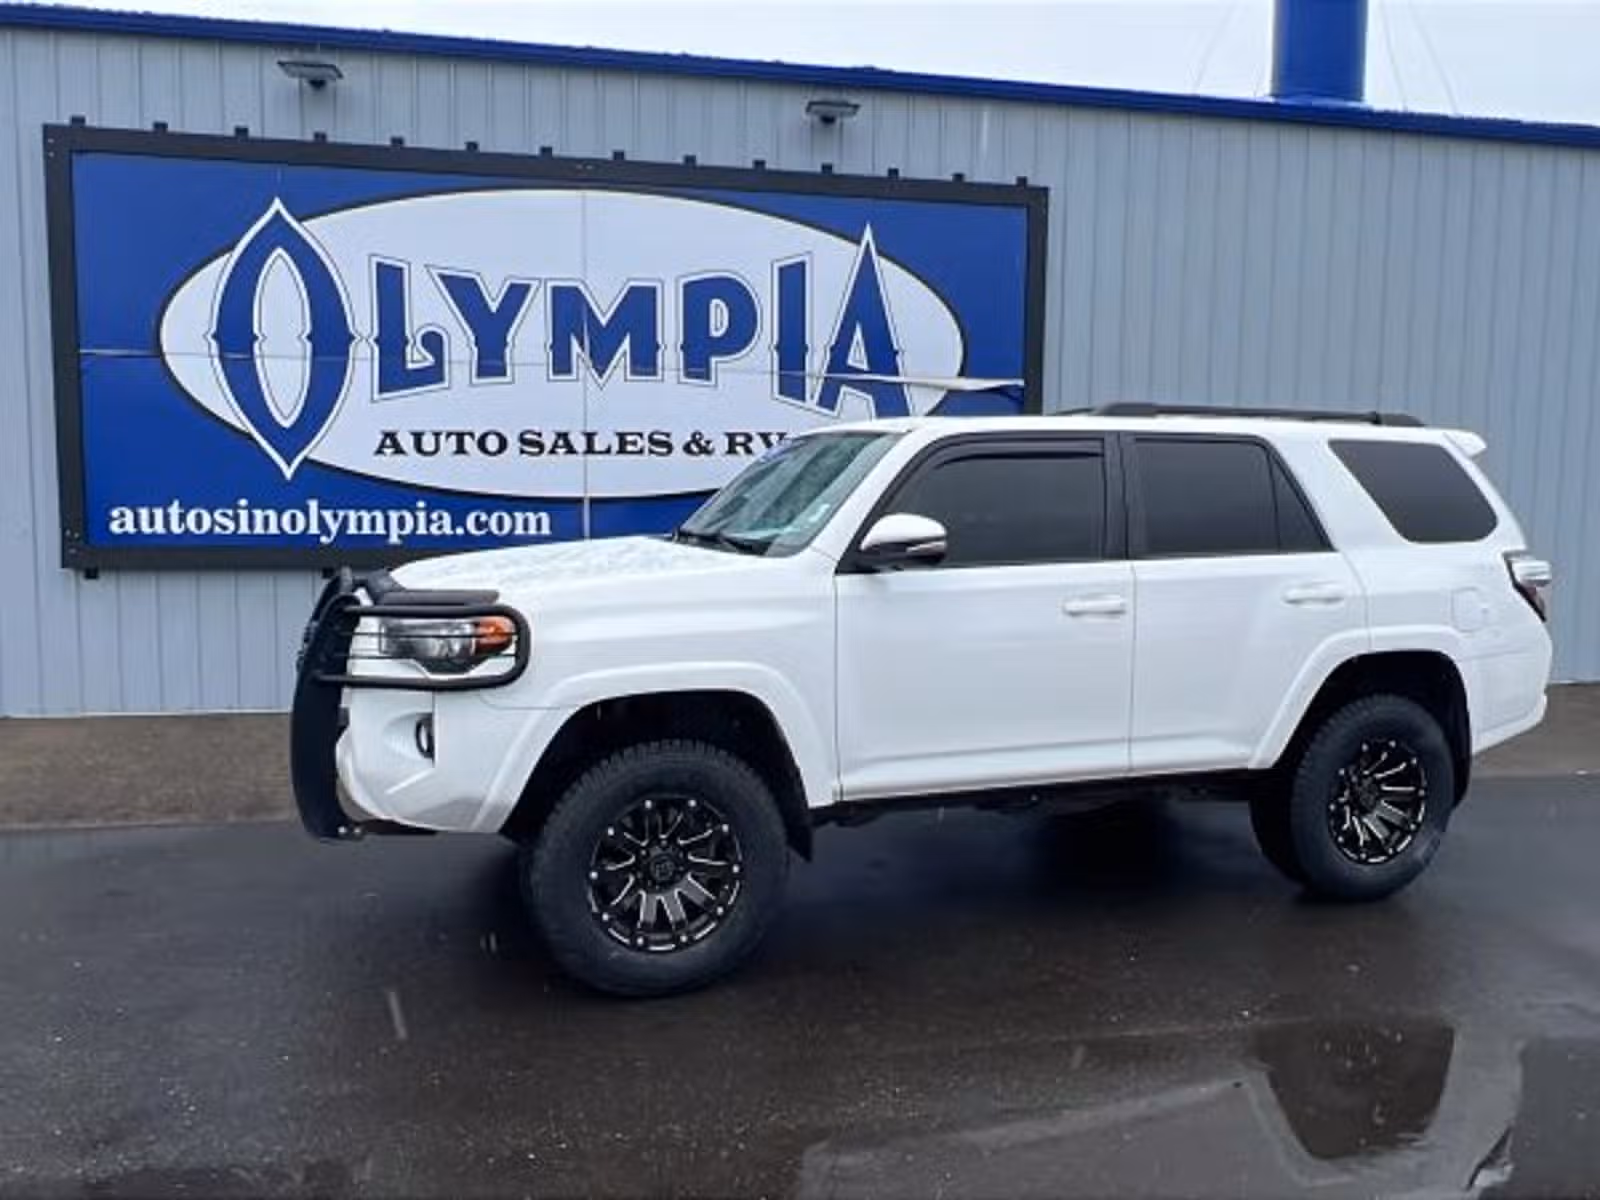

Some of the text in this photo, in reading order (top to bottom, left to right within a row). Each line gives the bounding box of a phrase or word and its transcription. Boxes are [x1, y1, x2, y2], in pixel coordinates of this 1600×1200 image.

[208, 198, 914, 479] OLYMPIA
[374, 430, 508, 456] AUTO
[518, 430, 674, 456] SALES
[682, 430, 716, 456] &
[108, 499, 552, 543] autosinolympia.com
